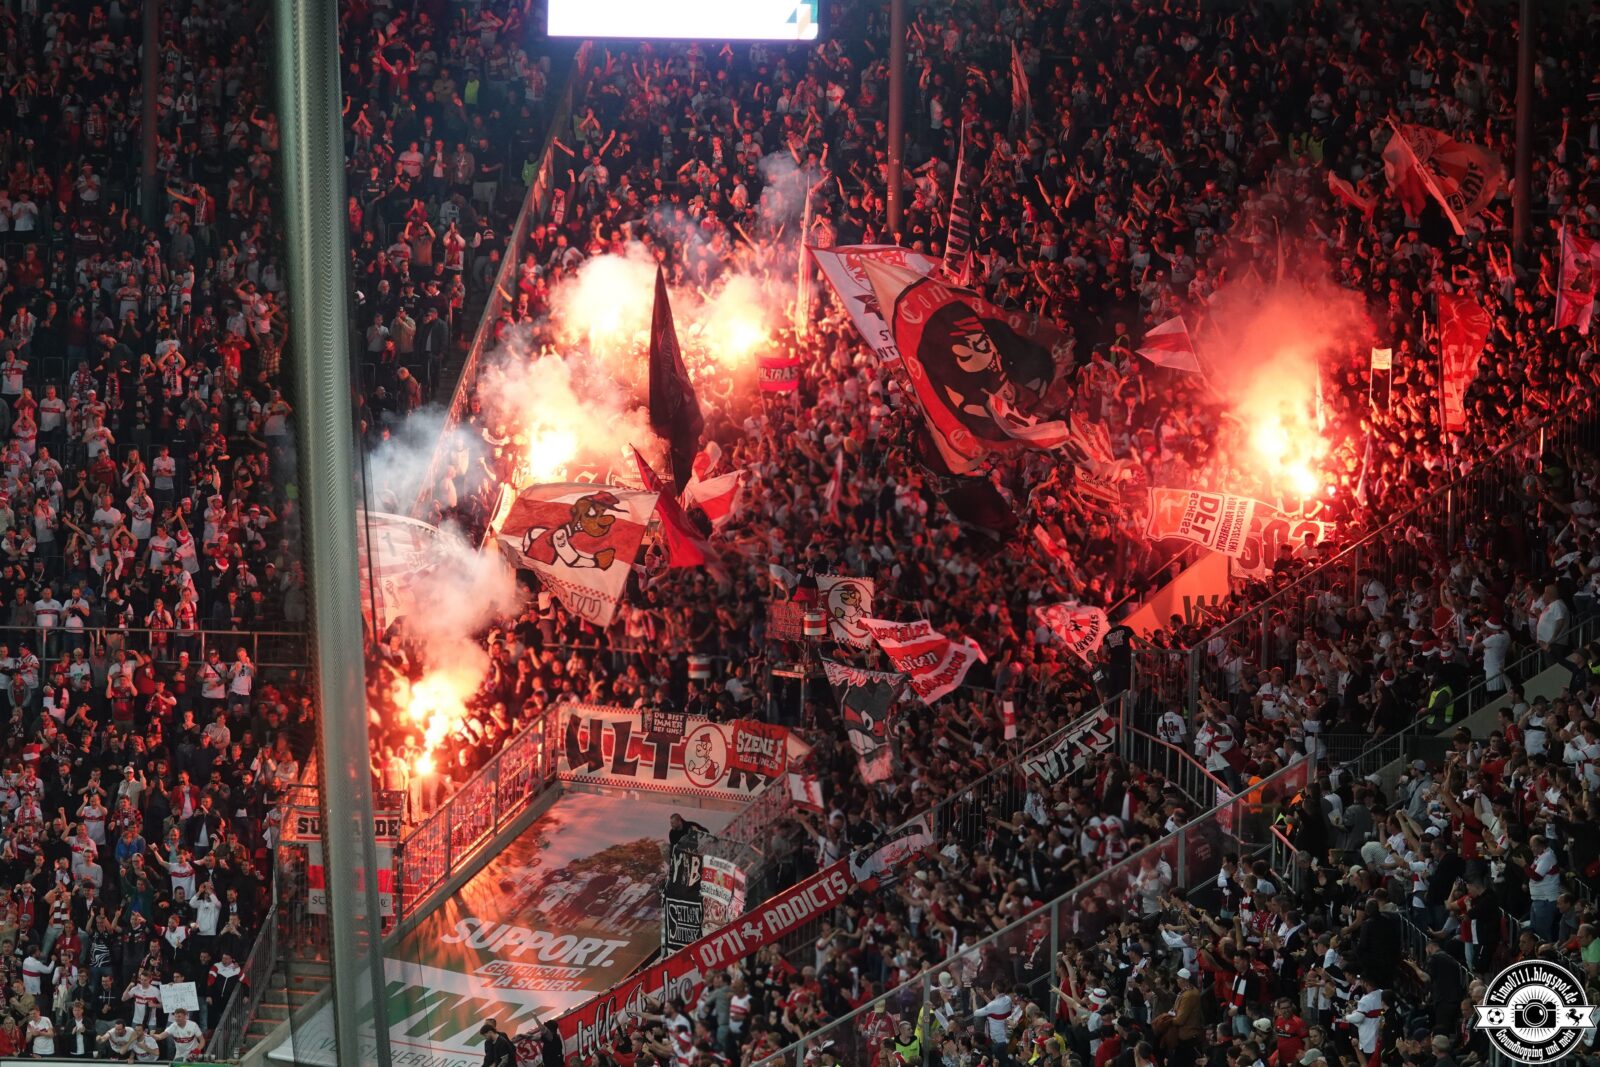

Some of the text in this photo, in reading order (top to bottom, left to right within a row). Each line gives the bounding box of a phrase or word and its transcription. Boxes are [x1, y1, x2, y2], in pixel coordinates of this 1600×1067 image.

[653, 719, 683, 728] IMMER
[654, 712, 684, 721] DU BIST
[736, 728, 774, 758] SZENE
[699, 928, 746, 967] 0711
[764, 870, 849, 934] ADDICTS
[440, 917, 631, 968] SUPPORT.
[484, 961, 581, 979] GEMEINSAM?
[491, 976, 582, 992] JA SICHER!
